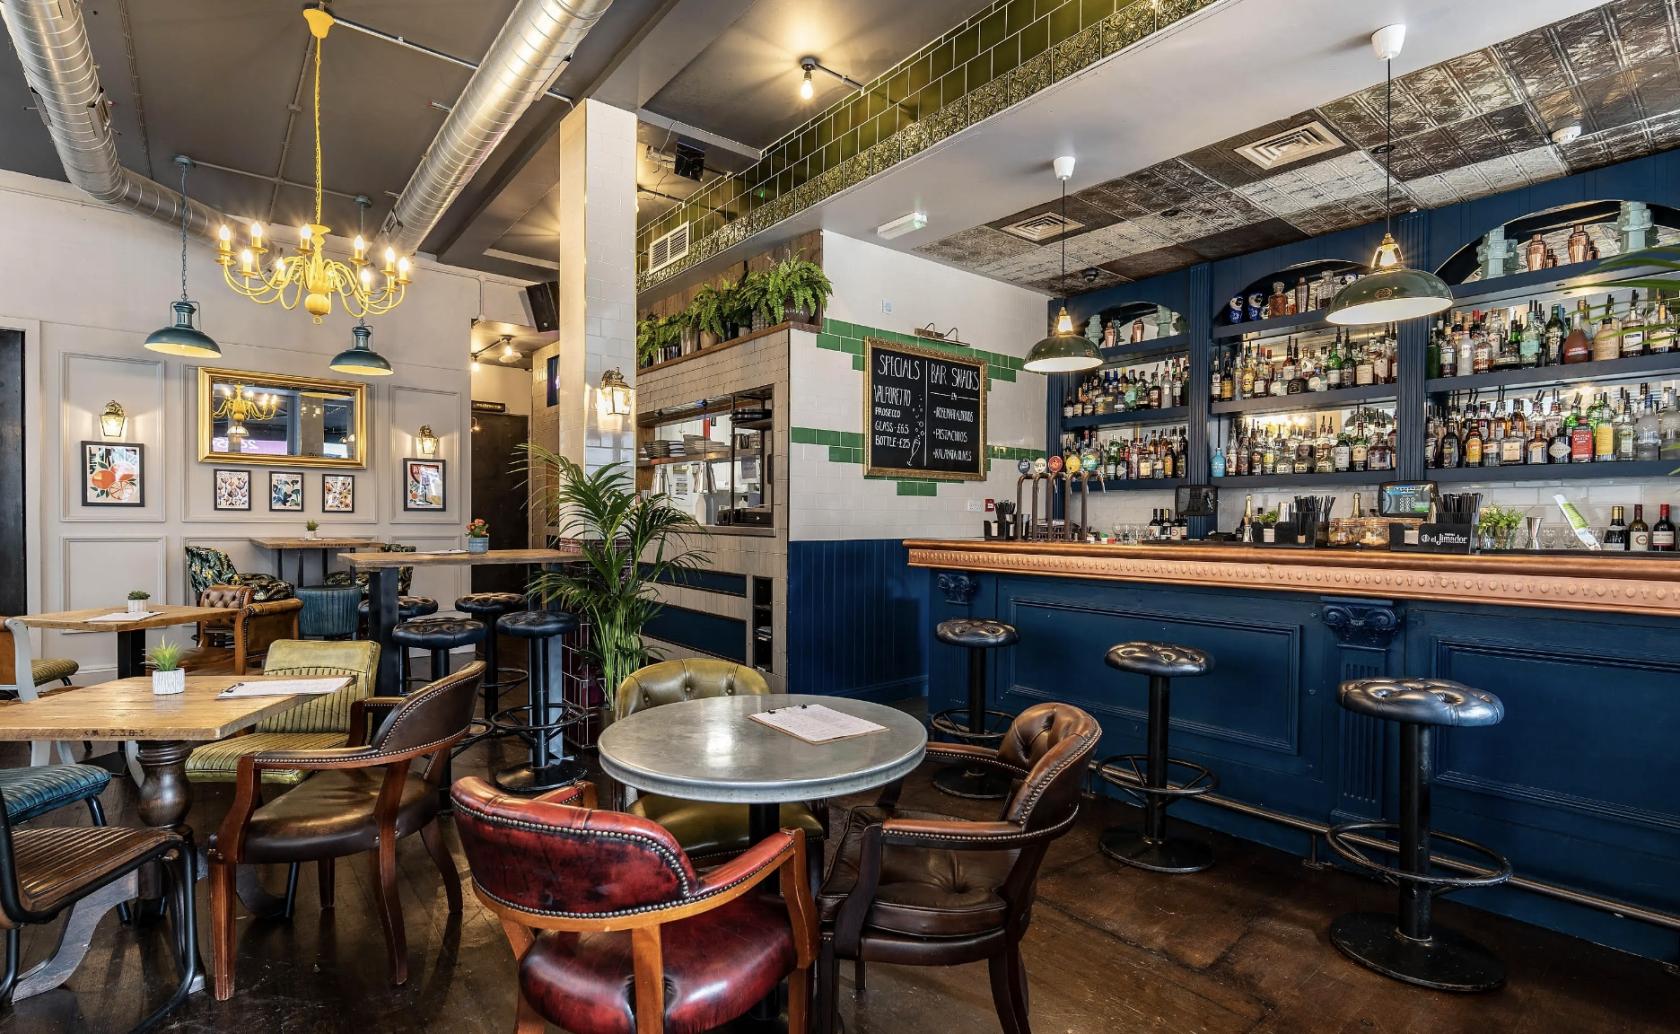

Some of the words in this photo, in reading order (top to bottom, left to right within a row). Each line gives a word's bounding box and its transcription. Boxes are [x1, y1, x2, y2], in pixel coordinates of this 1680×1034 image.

[878, 354, 920, 380] SPECIALS
[930, 363, 947, 385] BAR
[951, 367, 979, 391] SNACKS
[874, 406, 901, 418] PROSECCO
[1436, 533, 1468, 546] Jimador
